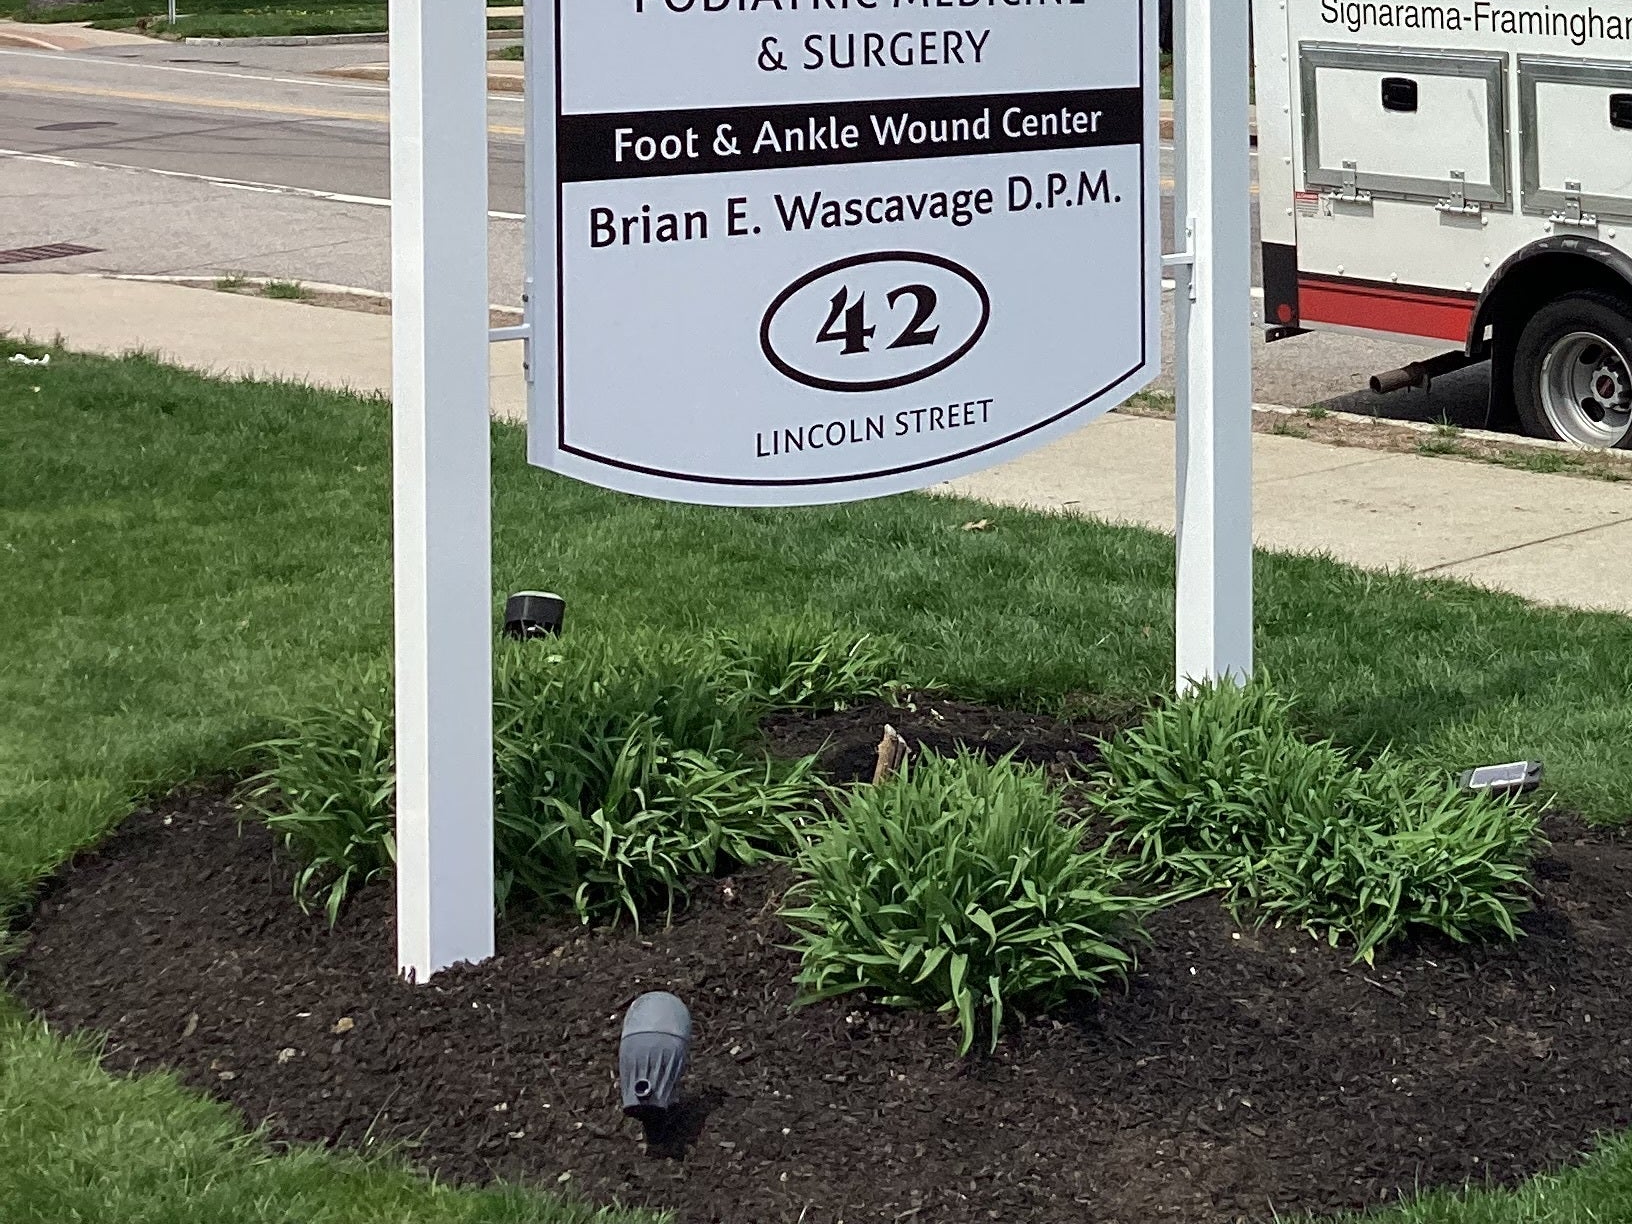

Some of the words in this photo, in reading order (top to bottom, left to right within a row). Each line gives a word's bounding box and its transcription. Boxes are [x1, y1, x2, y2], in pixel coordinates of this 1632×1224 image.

[757, 36, 788, 72] &
[803, 29, 991, 70] SURGERY
[615, 127, 699, 162] Foot
[712, 123, 742, 156] &
[752, 115, 859, 154] Ankle
[869, 107, 990, 146] Wound
[1002, 106, 1102, 138] Center
[590, 204, 708, 248] Brian
[727, 196, 761, 237] E.
[773, 188, 994, 232] Wascavage
[1008, 169, 1121, 212] D.P.M.
[815, 284, 940, 356] 42
[756, 414, 884, 458] LINCOLN
[895, 398, 994, 436] STREET
